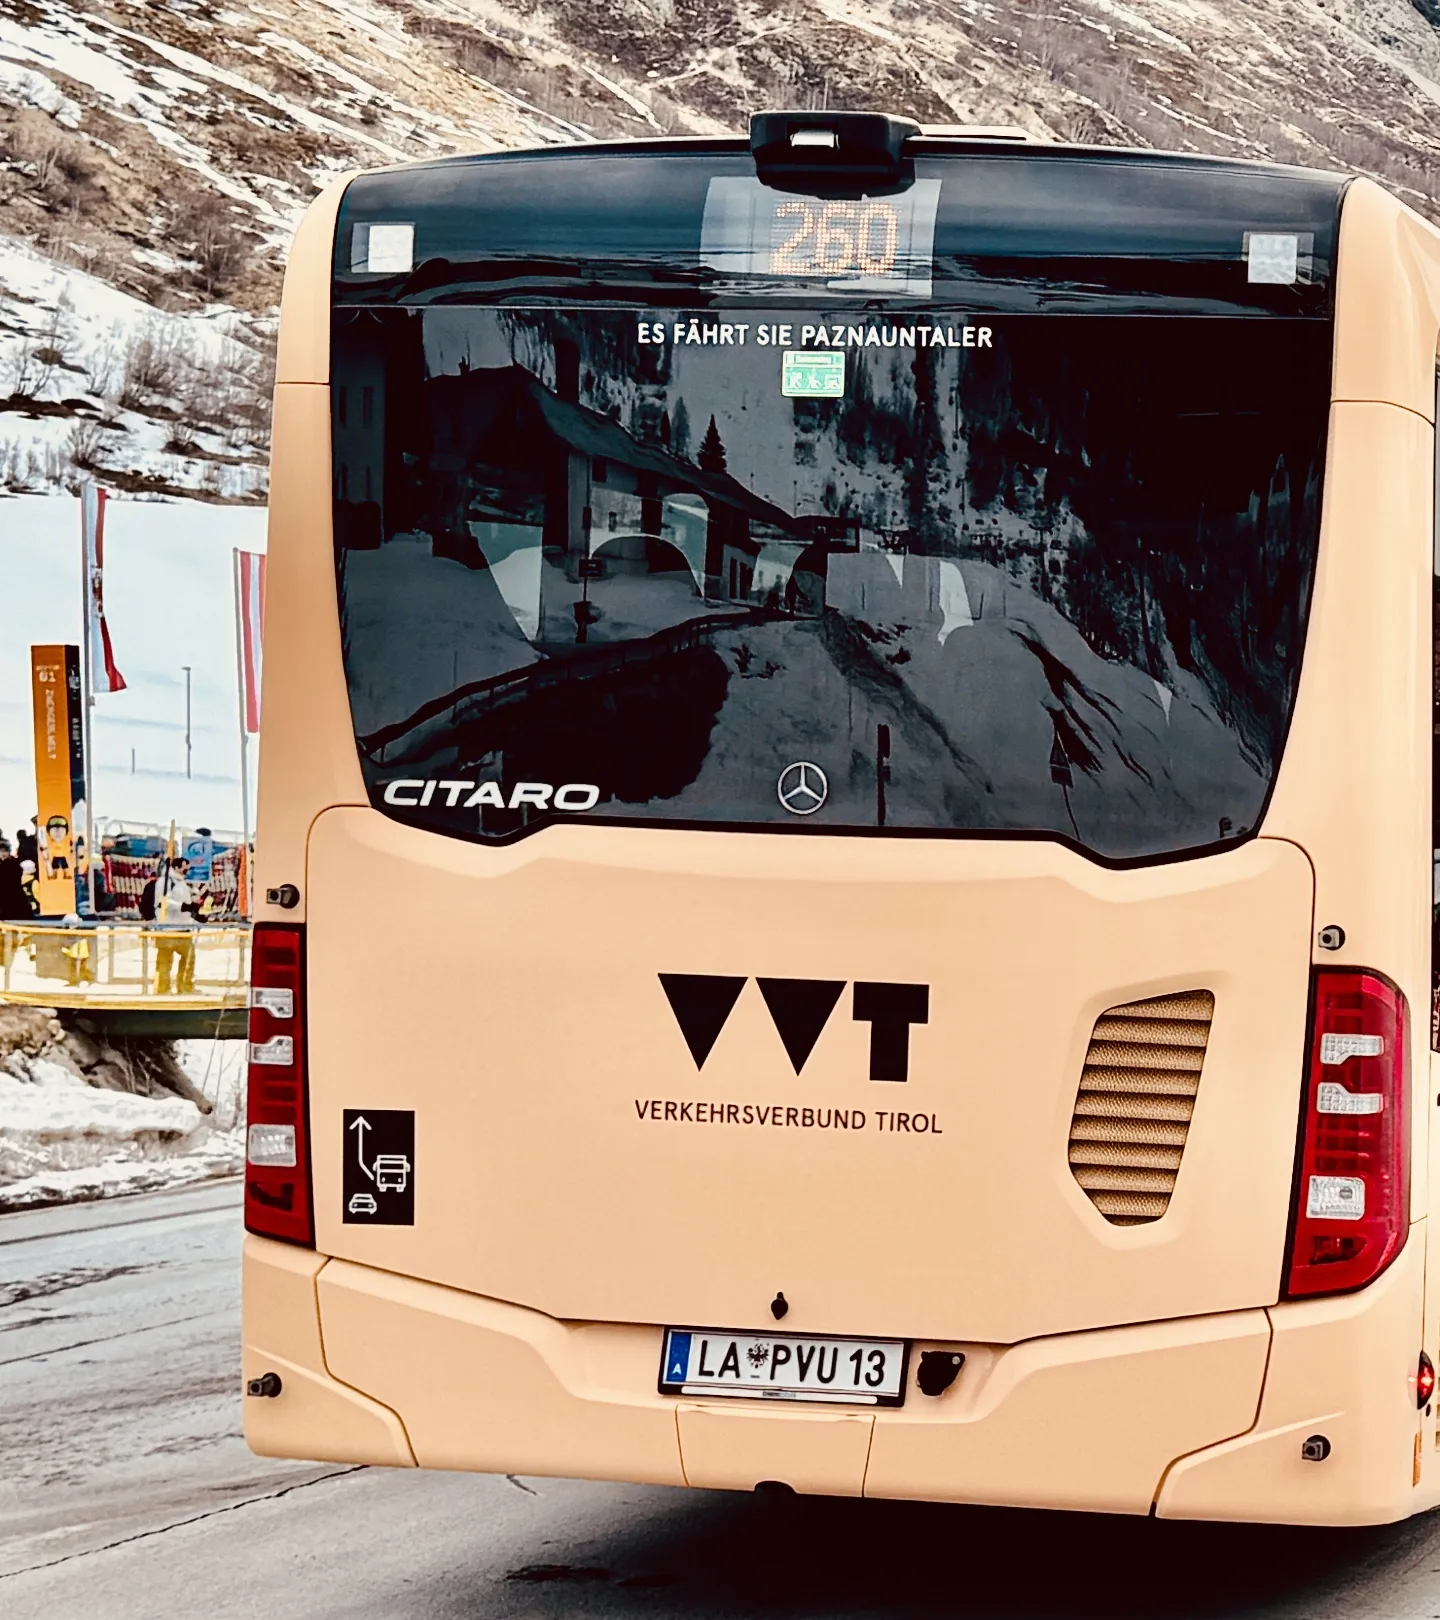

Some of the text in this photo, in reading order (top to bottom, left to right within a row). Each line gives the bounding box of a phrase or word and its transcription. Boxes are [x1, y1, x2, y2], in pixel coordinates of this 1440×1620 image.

[772, 201, 899, 275] 260
[637, 318, 993, 348] ES FÄHRT SIE PAZNAUNTALER
[383, 779, 600, 812] CITARO
[657, 972, 930, 1083] VVT
[634, 1099, 943, 1134] VERKEHRSVERBUND TIROL
[698, 1339, 741, 1379] LA
[769, 1343, 839, 1384] PVU
[849, 1347, 886, 1387] 13
